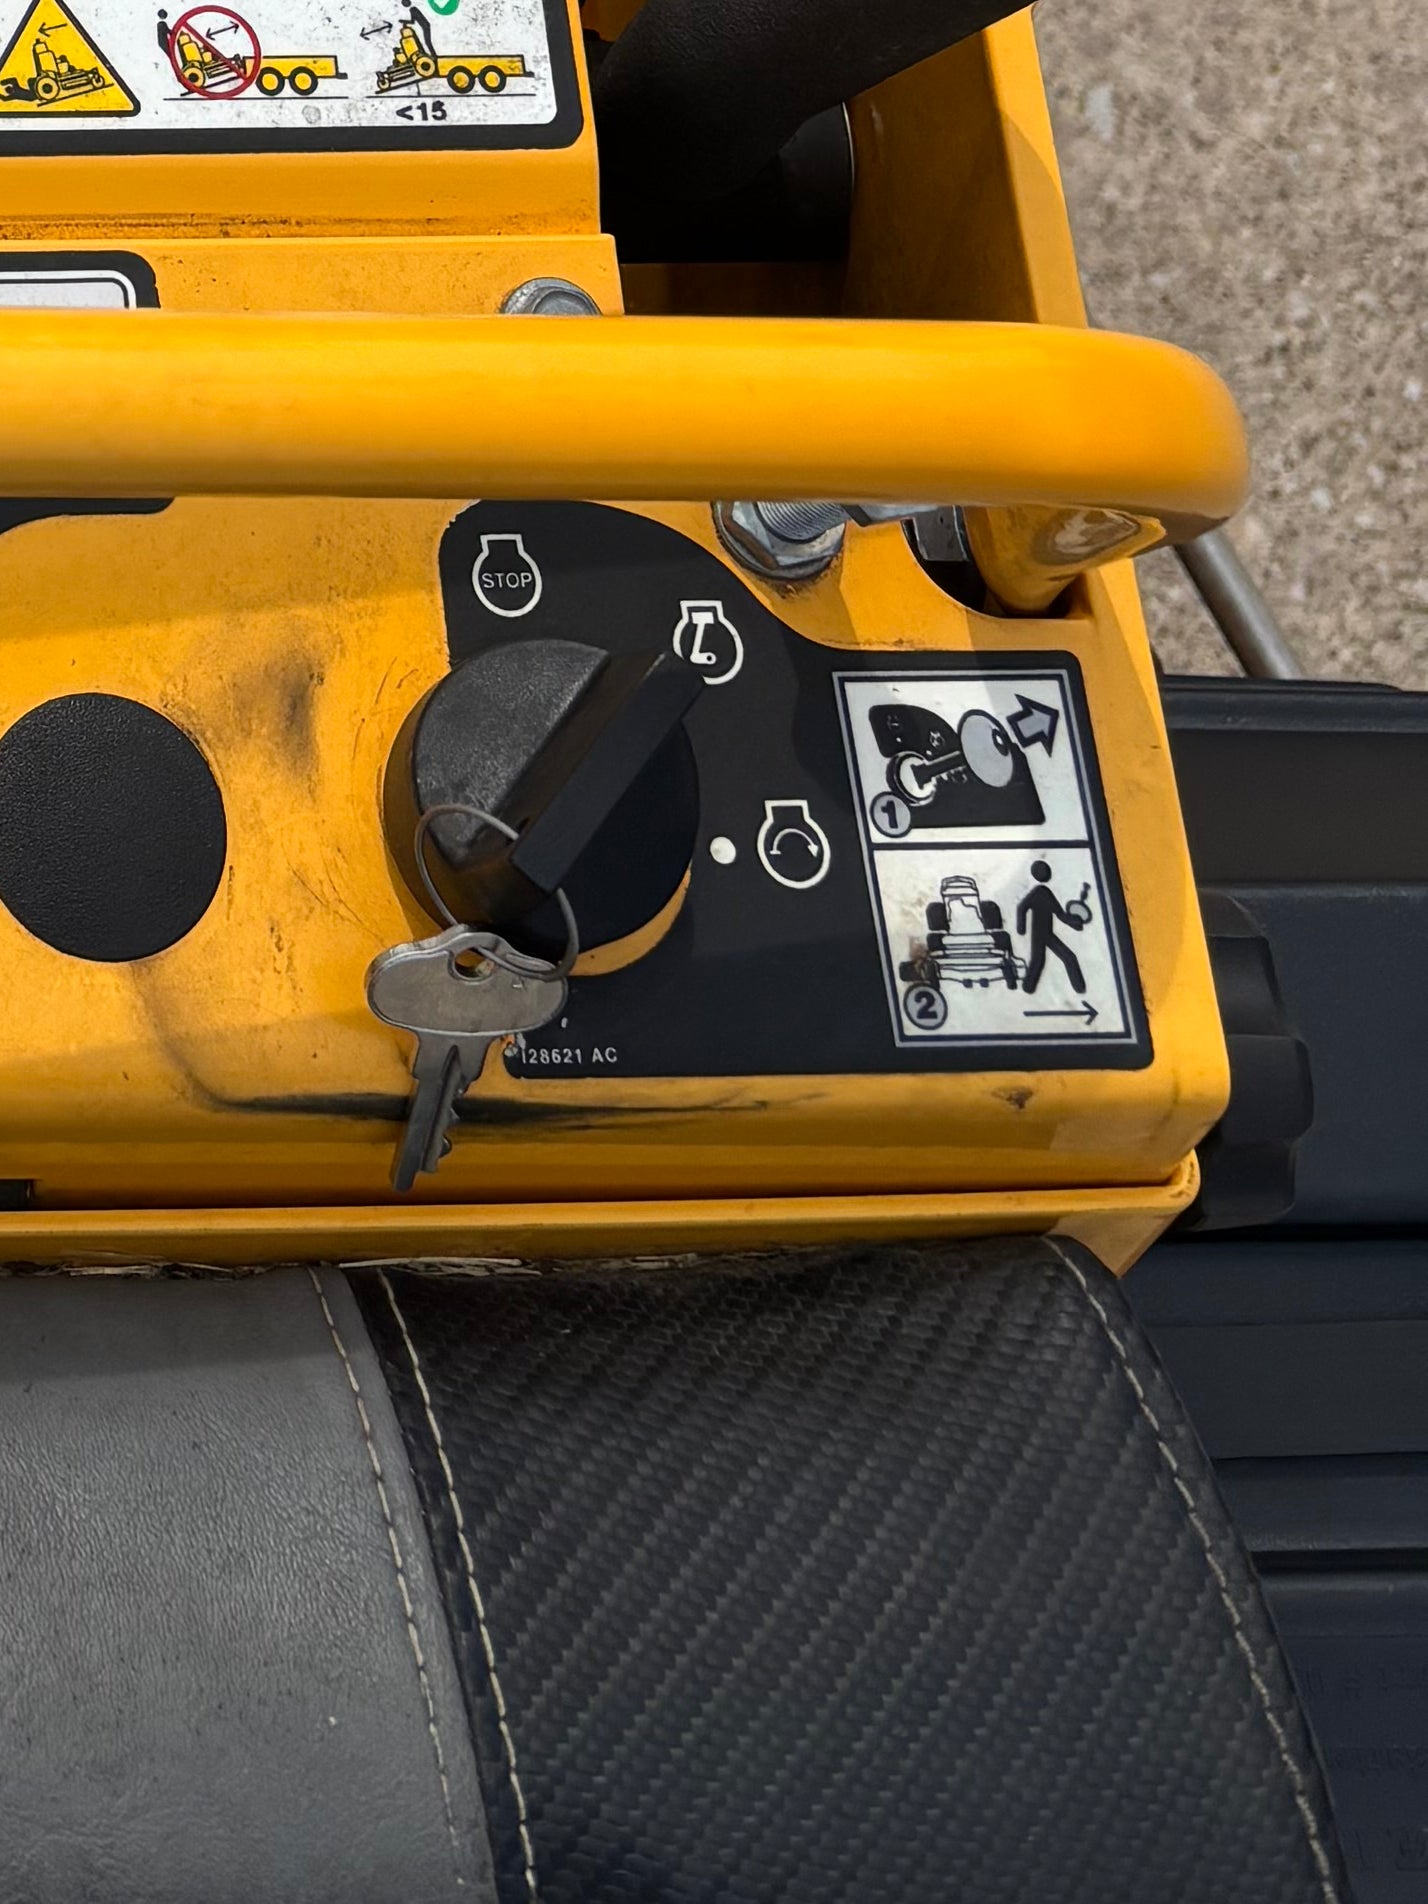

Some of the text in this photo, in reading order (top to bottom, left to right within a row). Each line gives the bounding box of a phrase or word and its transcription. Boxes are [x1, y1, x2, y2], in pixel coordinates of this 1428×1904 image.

[481, 572, 533, 589] STOP
[880, 799, 899, 829] 1
[913, 990, 939, 1020] 2
[520, 1047, 618, 1065] 128621 AC
